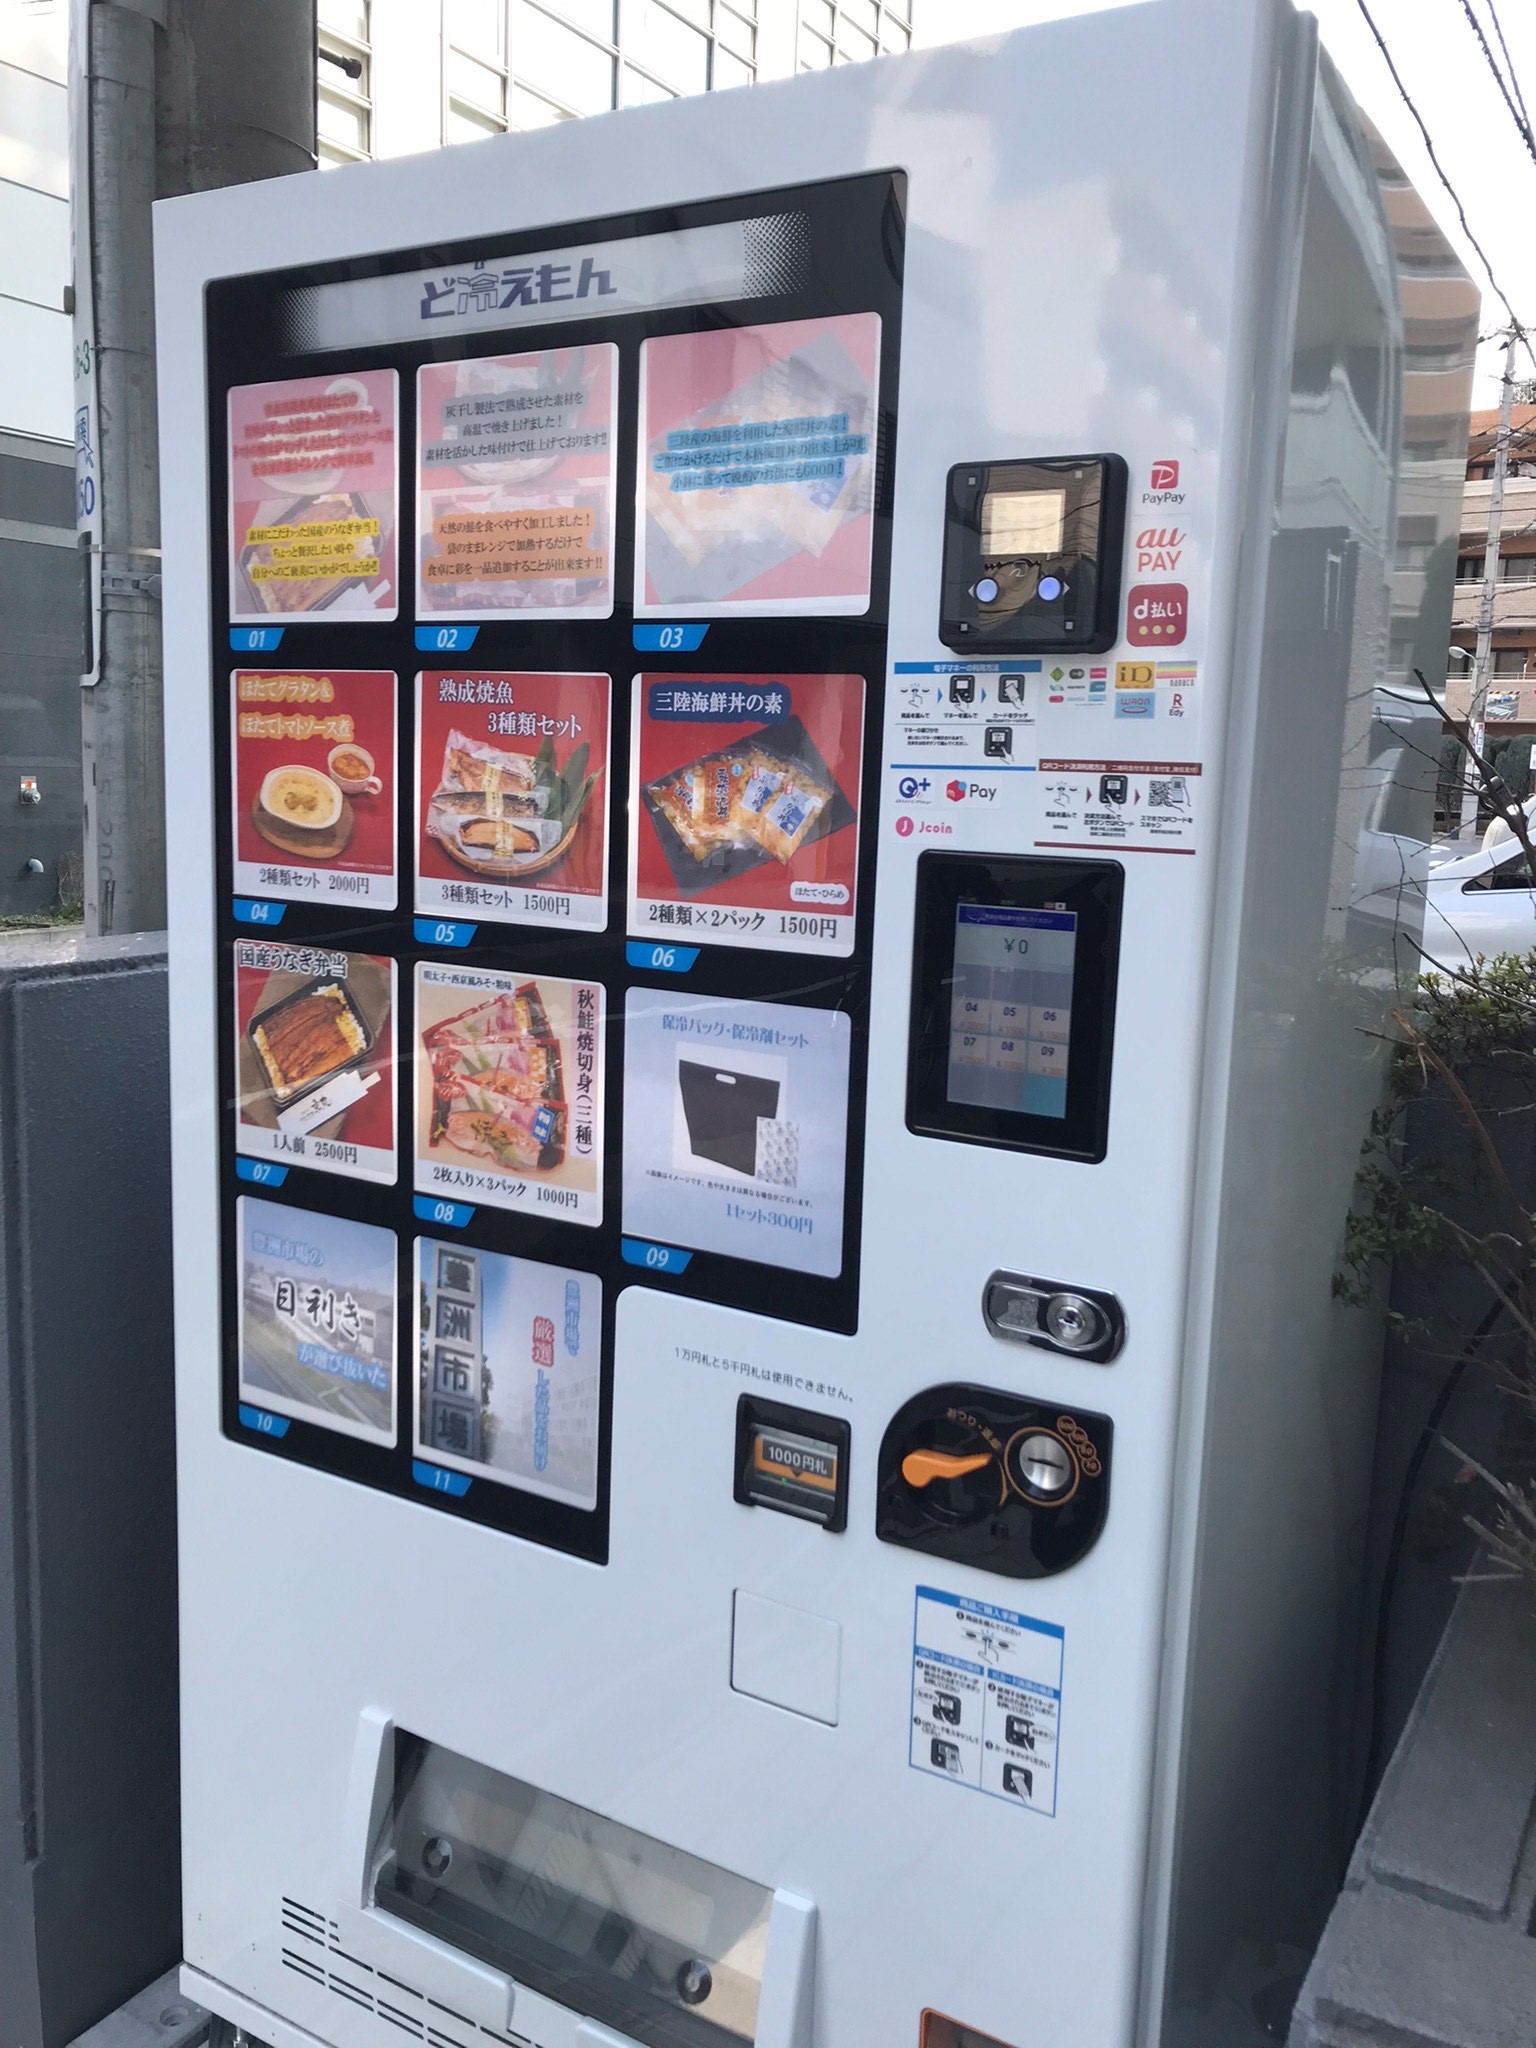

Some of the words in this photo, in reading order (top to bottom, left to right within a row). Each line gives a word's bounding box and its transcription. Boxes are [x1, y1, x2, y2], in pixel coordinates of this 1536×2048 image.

[421, 257, 617, 319] ど冷えもん
[446, 391, 584, 418] 灰干し製法で熟成させた素材を
[463, 415, 562, 437] 高温で焼き上げました!
[1142, 492, 1186, 504] PayPay
[447, 537, 583, 555] 袋のままレンジで加熱するだけで
[1136, 527, 1186, 549] au
[1138, 551, 1182, 572] PAY
[1133, 599, 1183, 618] d払い
[248, 630, 265, 648] 01
[437, 628, 458, 648] 02
[659, 627, 684, 648] 03
[1121, 666, 1152, 683] iD
[439, 678, 514, 704] 熟成焼魚
[655, 691, 783, 714] 三陸海鮮丼の素
[1169, 708, 1184, 717] Edy
[241, 717, 351, 737] ほたてトマトソース煮
[488, 711, 582, 738] 3種類セット
[970, 784, 997, 801] Pay
[259, 868, 320, 889] 2種類セット
[329, 875, 370, 894] 2000円
[441, 884, 513, 908] 3種類セット
[524, 894, 570, 915] 1500円
[795, 887, 845, 899] ほたて・ひらめ
[251, 904, 268, 921] 04
[649, 904, 766, 931] 2種類×2パック
[780, 916, 838, 939] 1500円
[435, 924, 455, 943] 05
[240, 944, 348, 978] 国産うなぎ弁当
[651, 947, 675, 967] 06
[965, 1002, 978, 1012] 04
[1003, 1007, 1016, 1017] 05
[1043, 1011, 1057, 1021] 06
[662, 1014, 809, 1049] 保冷バッグ・保冷剤セット
[963, 1036, 976, 1046] 07
[1001, 1041, 1014, 1051] 08
[1041, 1046, 1054, 1056] 09
[272, 1134, 305, 1154] 1人前
[315, 1142, 358, 1164] 2500円
[253, 1164, 270, 1181] 07
[433, 1167, 526, 1197] 2枚入り×3パック
[537, 1186, 578, 1208] 1000円
[434, 1203, 454, 1221] 08
[726, 1203, 813, 1235] 1セット300円
[646, 1246, 669, 1267] 09
[276, 1279, 361, 1339] 目利き
[675, 1347, 853, 1402] 1万円札と5千円札は使用できません。
[256, 1412, 272, 1431] 10
[769, 1445, 828, 1475] 1000円札
[434, 1471, 450, 1490] 11
